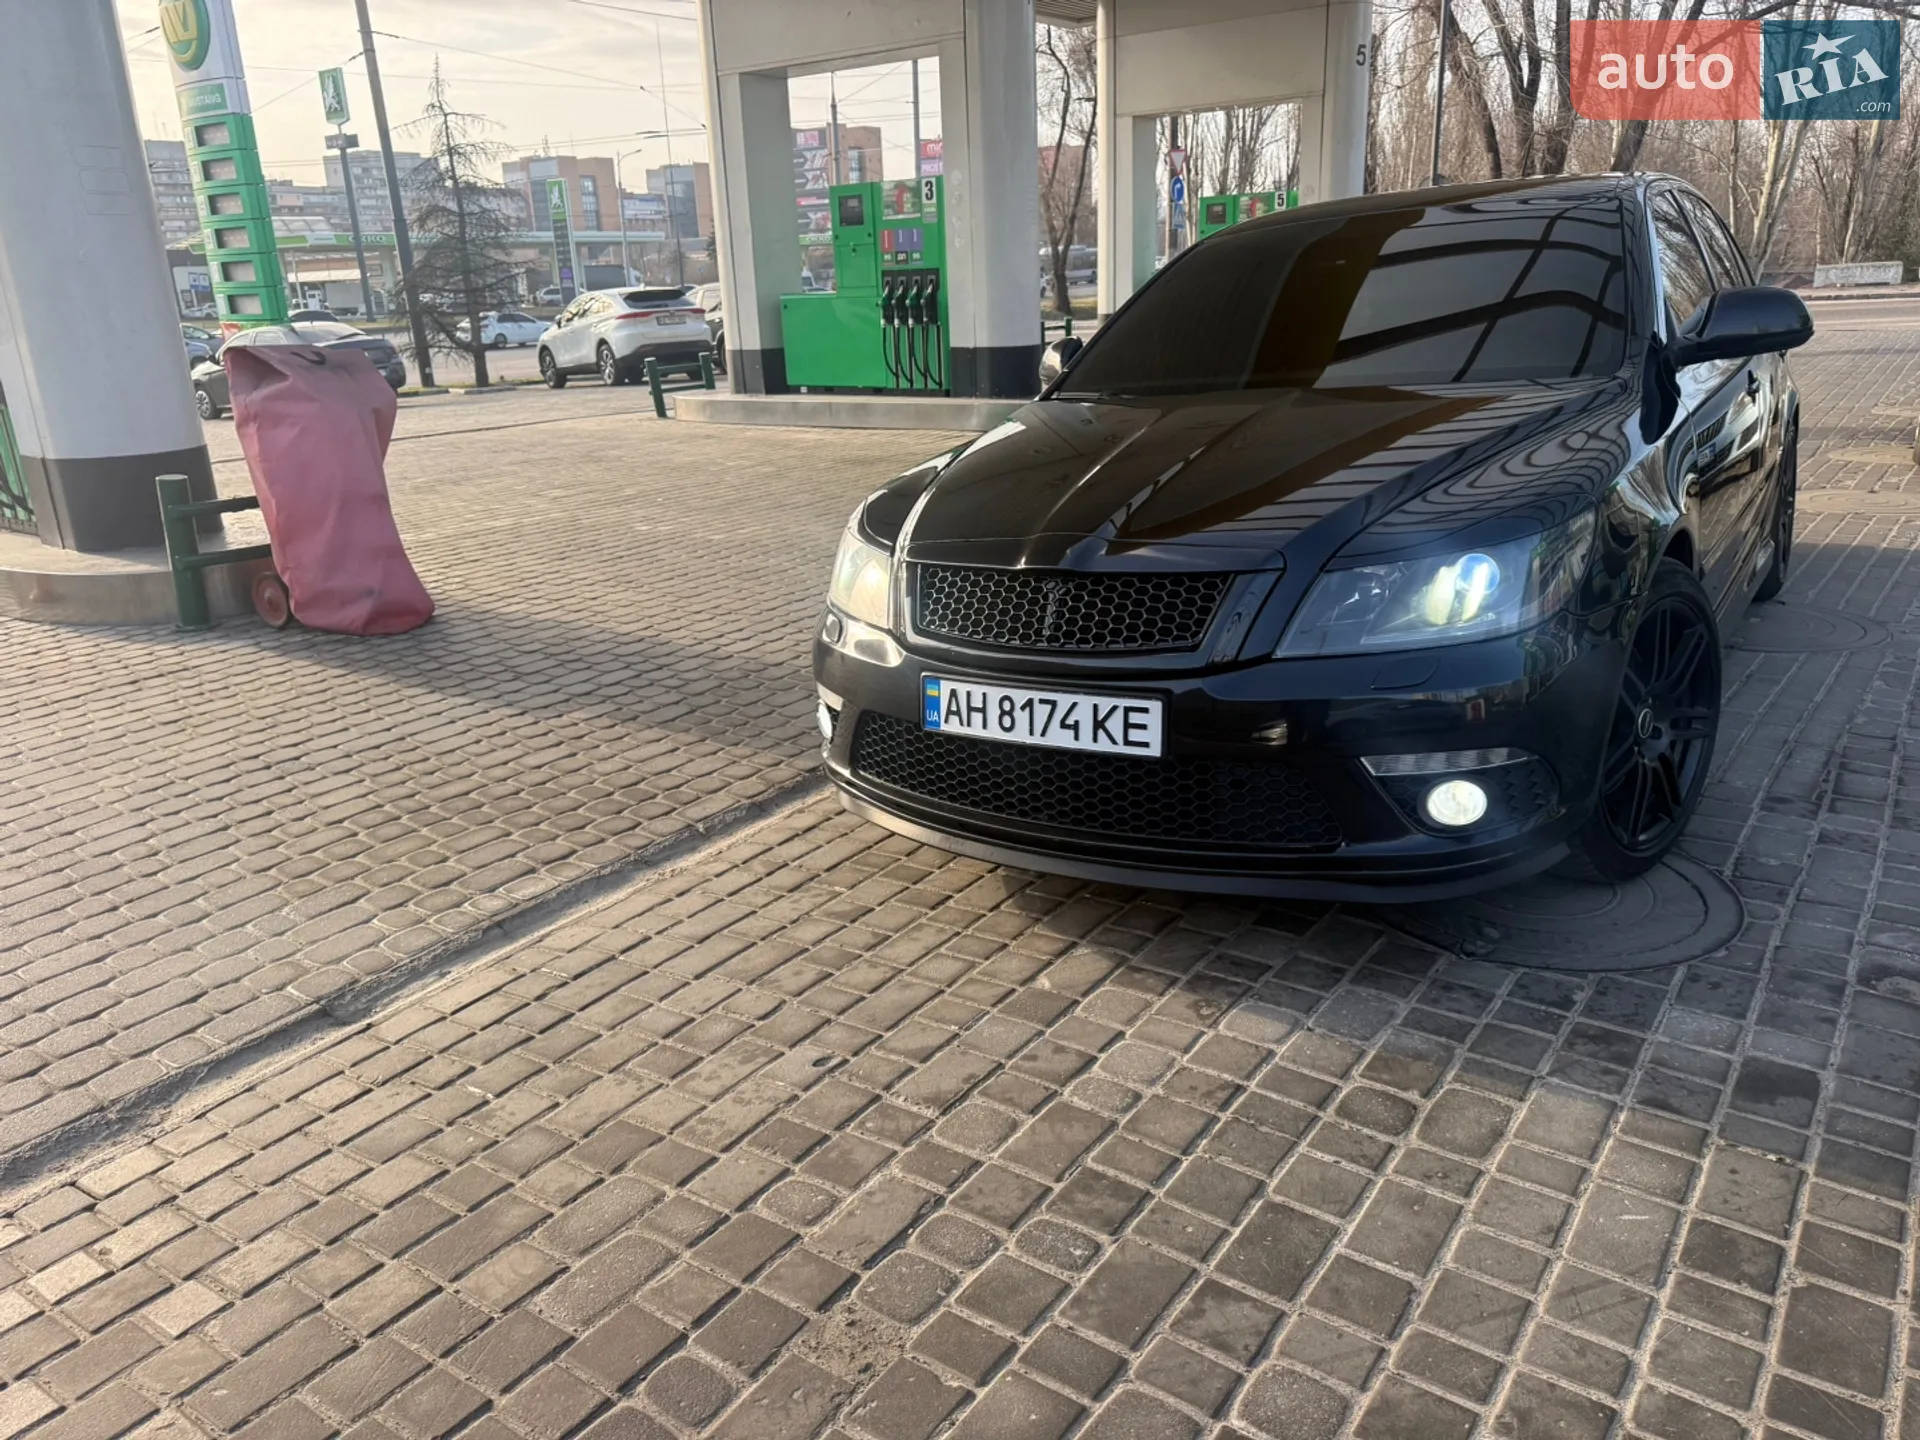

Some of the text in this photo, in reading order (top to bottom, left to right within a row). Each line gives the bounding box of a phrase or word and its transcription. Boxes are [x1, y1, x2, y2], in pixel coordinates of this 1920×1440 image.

[1356, 44, 1367, 66] 5
[924, 180, 934, 201] 3
[1277, 193, 1285, 207] 5
[926, 711, 939, 723] UA
[944, 687, 1151, 749] AH 8174 KE
